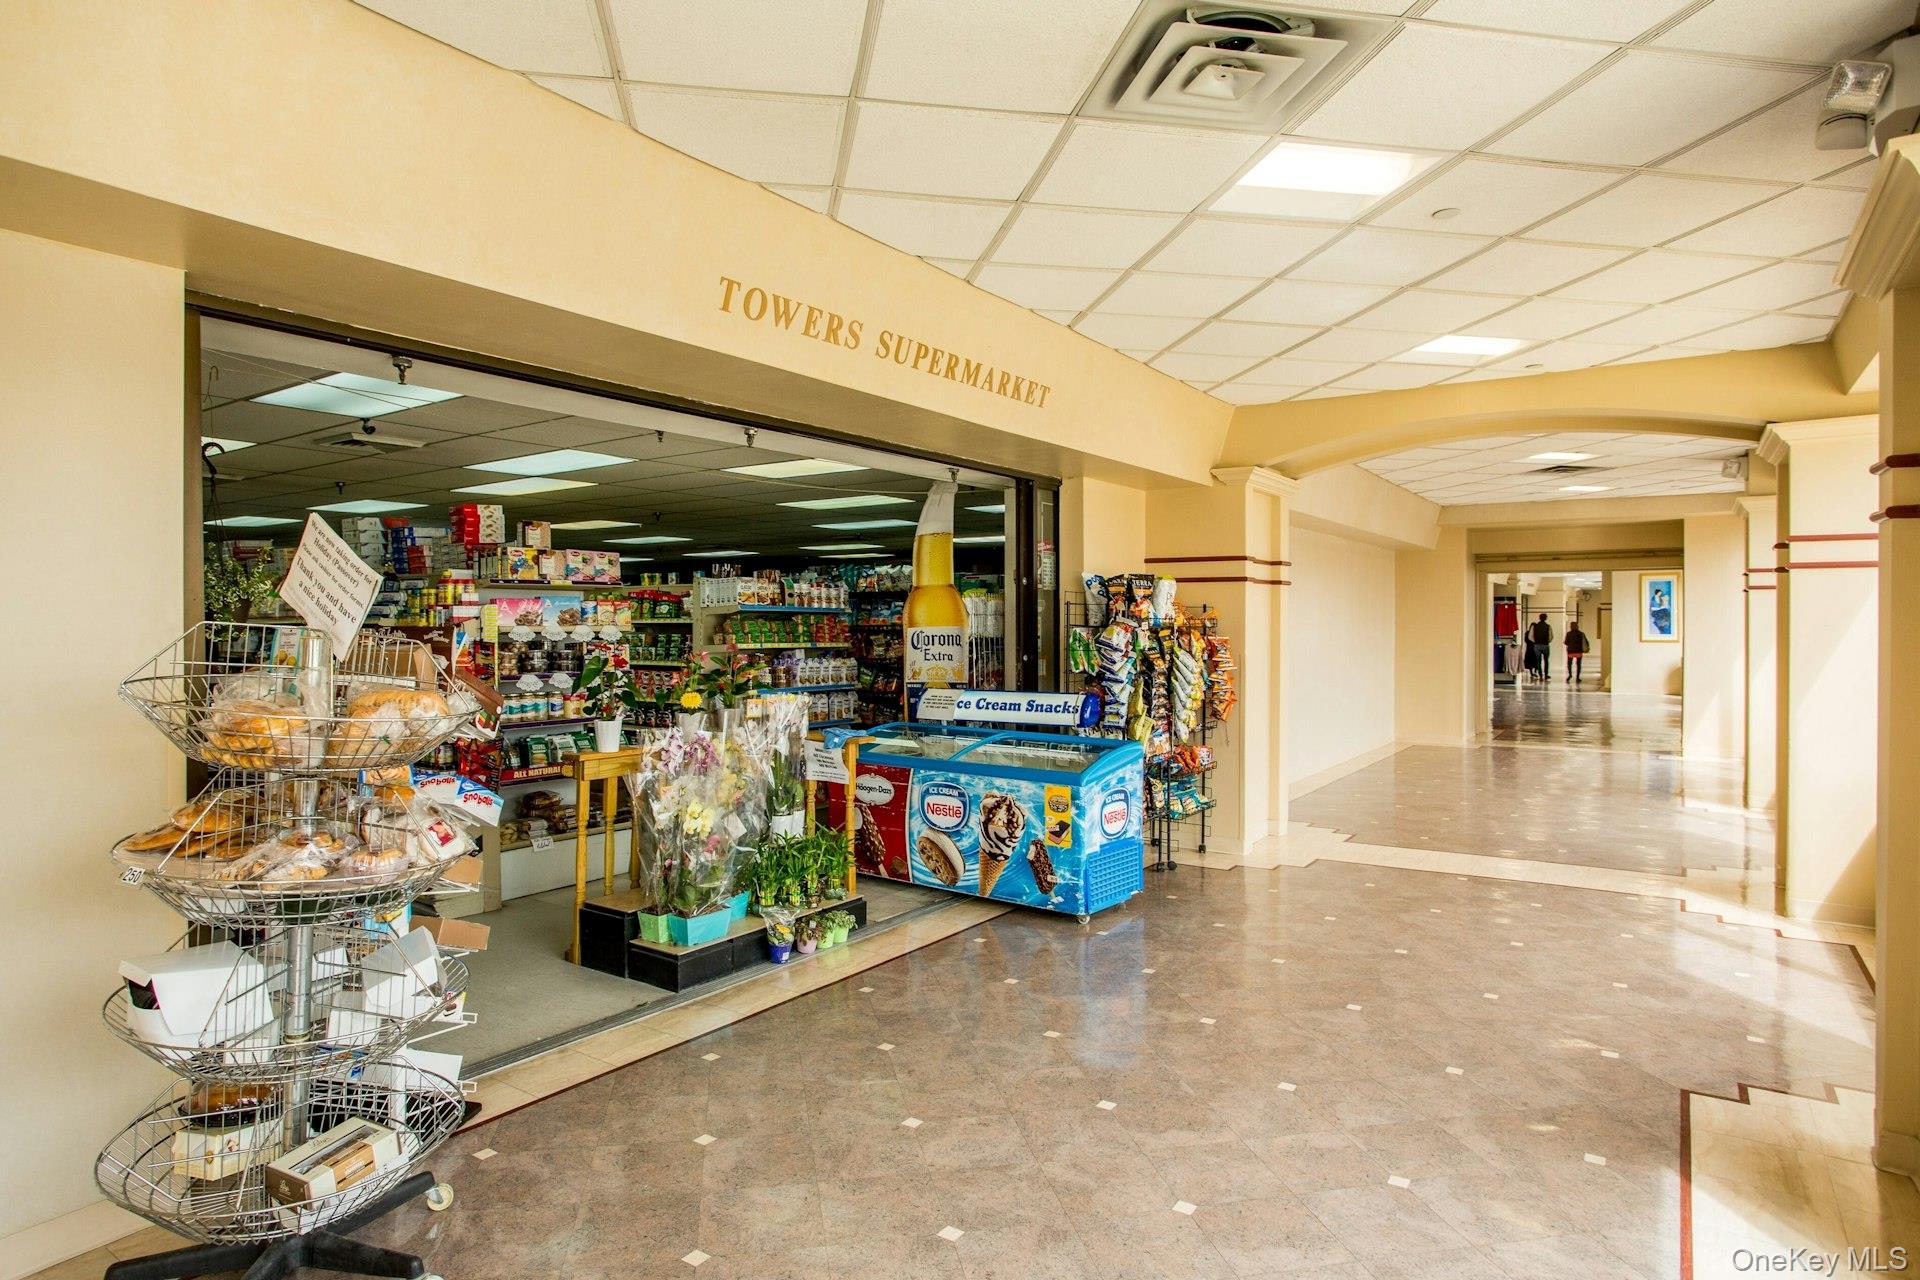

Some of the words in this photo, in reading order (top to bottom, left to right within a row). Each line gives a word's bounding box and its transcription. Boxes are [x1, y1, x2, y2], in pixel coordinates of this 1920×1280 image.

[718, 276, 864, 351] TOWERS
[875, 329, 1051, 409] SUPERMARKET
[311, 520, 319, 532] We
[318, 529, 326, 538] are
[325, 537, 335, 547] now
[335, 546, 350, 565] taking
[350, 562, 364, 577] order
[365, 574, 373, 585] for
[314, 538, 332, 561] Holiday
[332, 558, 360, 588] (Passover)
[295, 556, 314, 581] Thank
[313, 578, 326, 595] you
[325, 591, 338, 607] and
[338, 602, 357, 623] have
[338, 582, 350, 595] order
[1131, 579, 1153, 587] TERRA
[298, 580, 304, 588] a
[303, 586, 315, 602] nice
[315, 597, 338, 626] holiday
[911, 630, 963, 651] Corona
[924, 649, 953, 662] Extra
[976, 697, 1021, 712] Cream
[1025, 698, 1080, 715] Snacks
[513, 770, 527, 779] ALL
[928, 786, 938, 794] ICE
[938, 787, 959, 797] CREAM
[927, 801, 962, 819] Nestlé
[122, 867, 143, 883] 250
